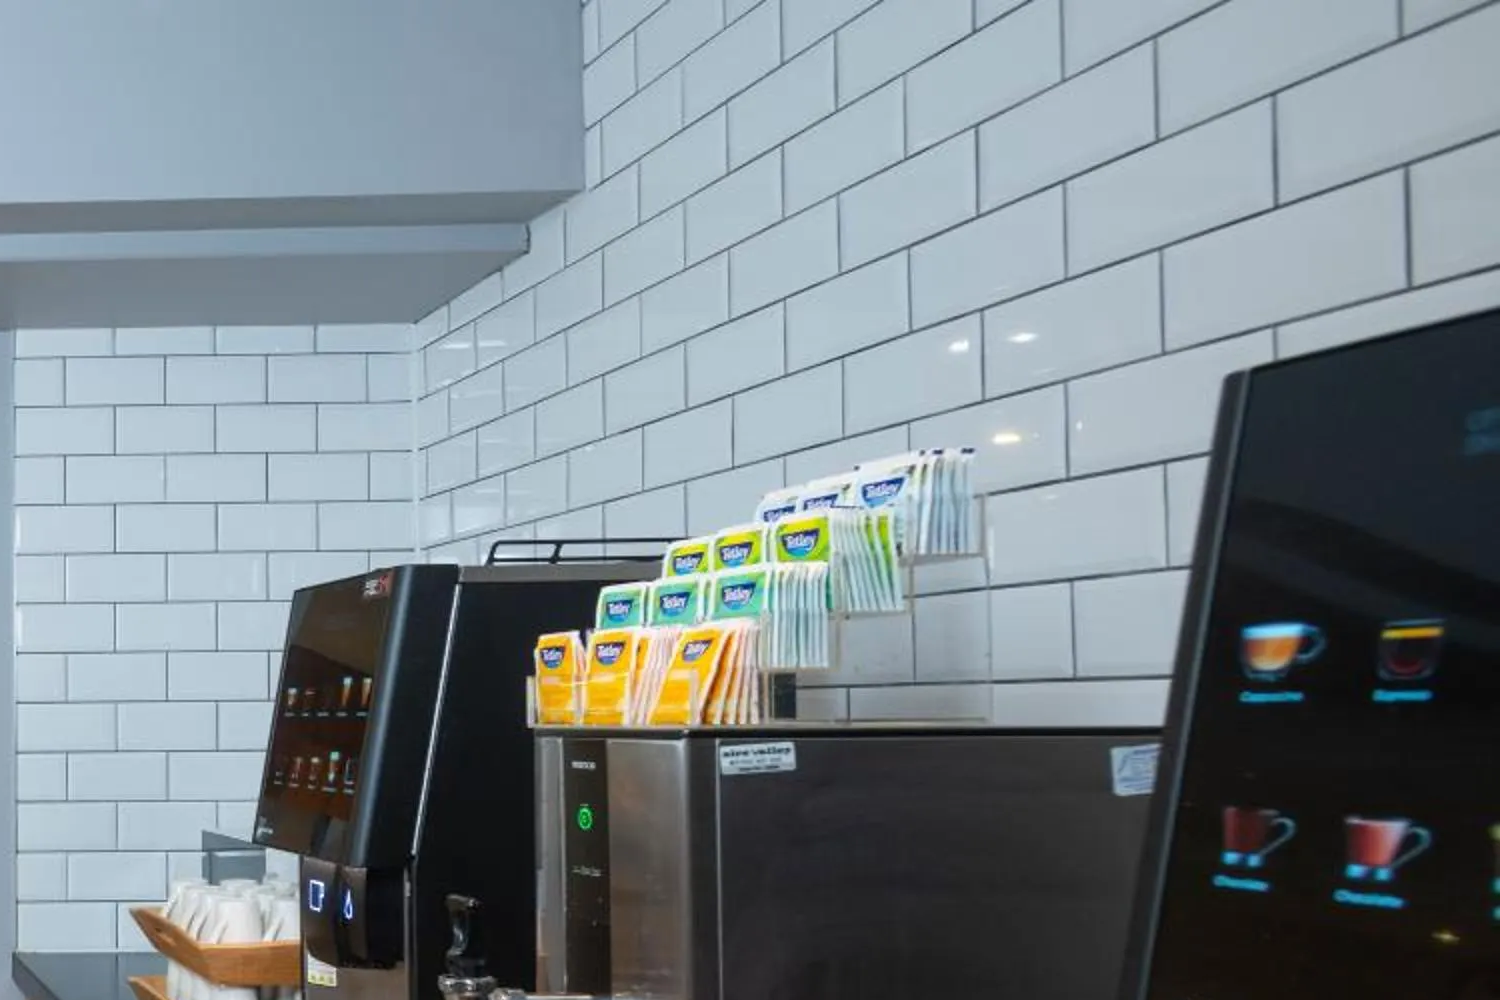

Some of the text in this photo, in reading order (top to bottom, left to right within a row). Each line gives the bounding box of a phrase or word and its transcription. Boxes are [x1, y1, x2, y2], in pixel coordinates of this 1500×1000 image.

[866, 483, 898, 498] Tetley
[785, 532, 815, 550] Tetley
[722, 546, 750, 561] Tetley
[674, 557, 699, 571] Tetley
[661, 596, 686, 609] Tetley
[723, 587, 751, 604] Tetley
[607, 603, 631, 616] Tetley
[540, 648, 565, 662] Tetley
[596, 643, 624, 658] Tetley
[682, 641, 710, 656] Tetley
